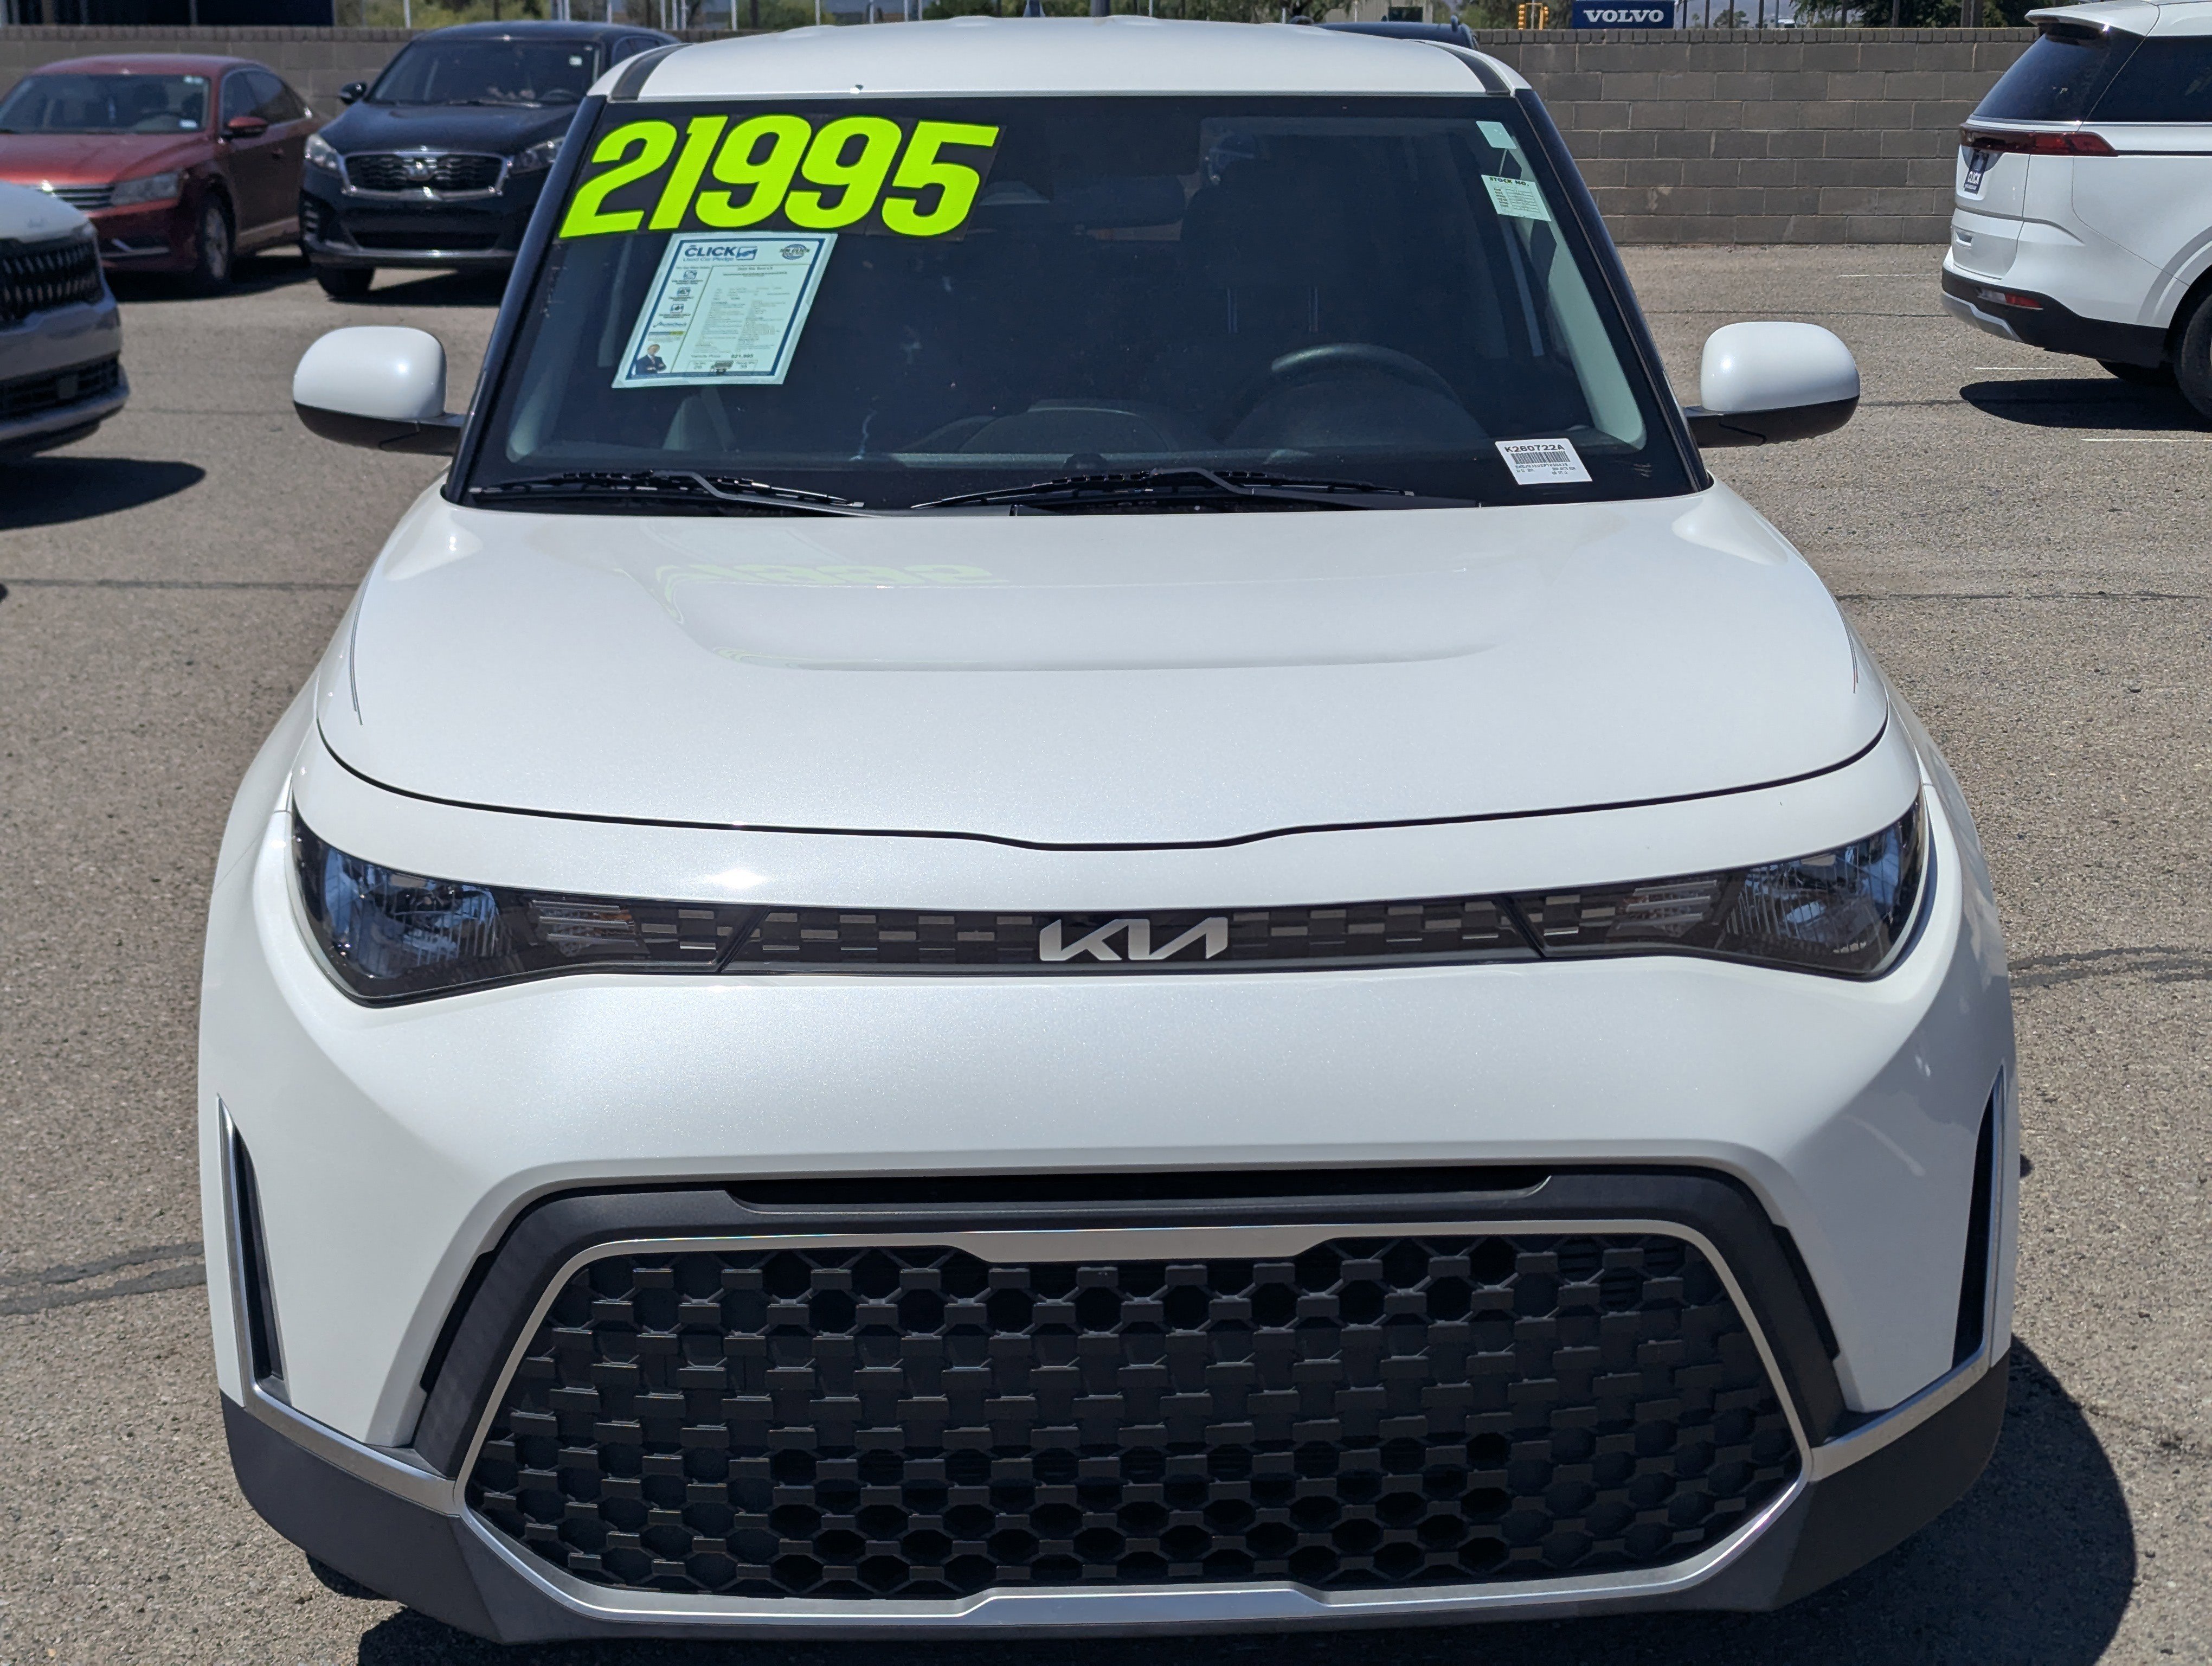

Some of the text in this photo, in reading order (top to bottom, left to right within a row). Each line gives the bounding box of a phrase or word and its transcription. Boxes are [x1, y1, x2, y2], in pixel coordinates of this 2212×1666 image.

[1583, 10, 1664, 22] VOLVO
[559, 115, 999, 238] 21995
[685, 247, 737, 257] CLICK
[1039, 917, 1228, 961] KIA
